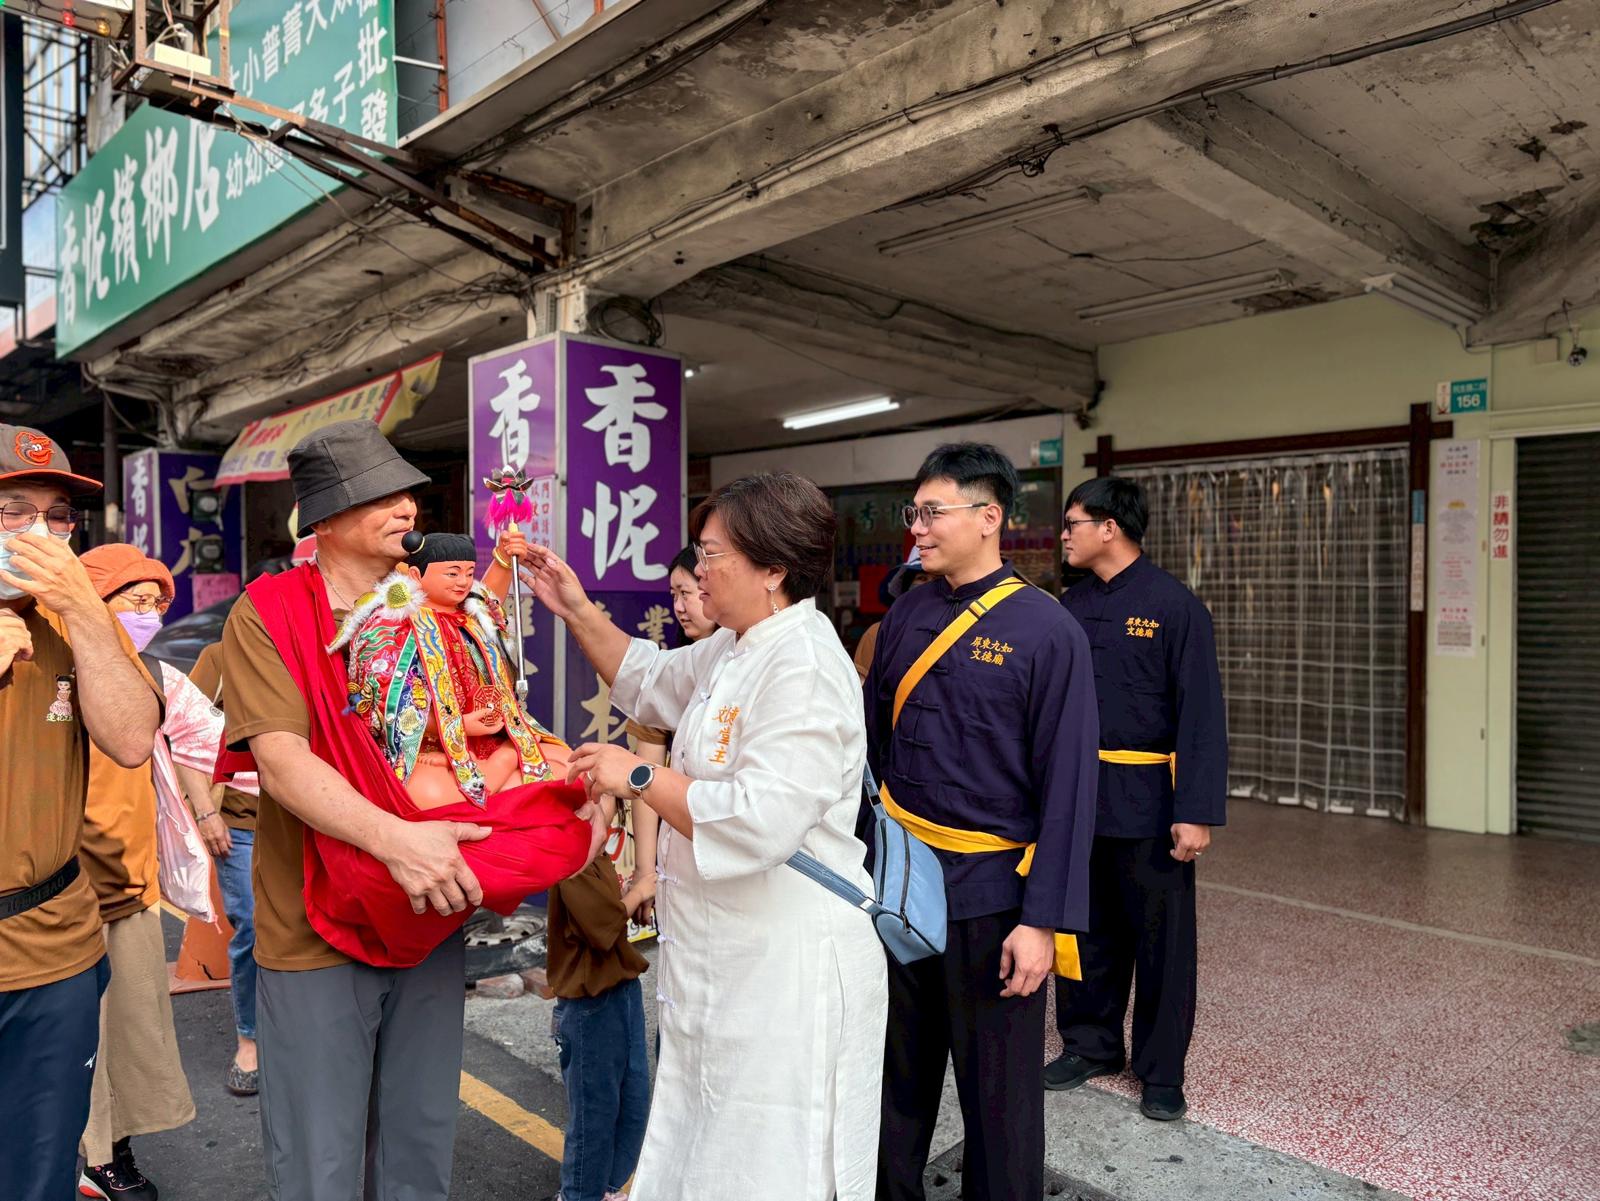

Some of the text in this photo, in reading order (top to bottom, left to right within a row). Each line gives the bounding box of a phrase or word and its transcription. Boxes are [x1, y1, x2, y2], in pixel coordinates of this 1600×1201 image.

[1456, 394, 1480, 409] 156
[581, 363, 669, 581] 香怩
[1493, 494, 1509, 559] 非請勿進
[1125, 617, 1160, 628] 屏東九如
[970, 636, 1013, 653] 屏東九如
